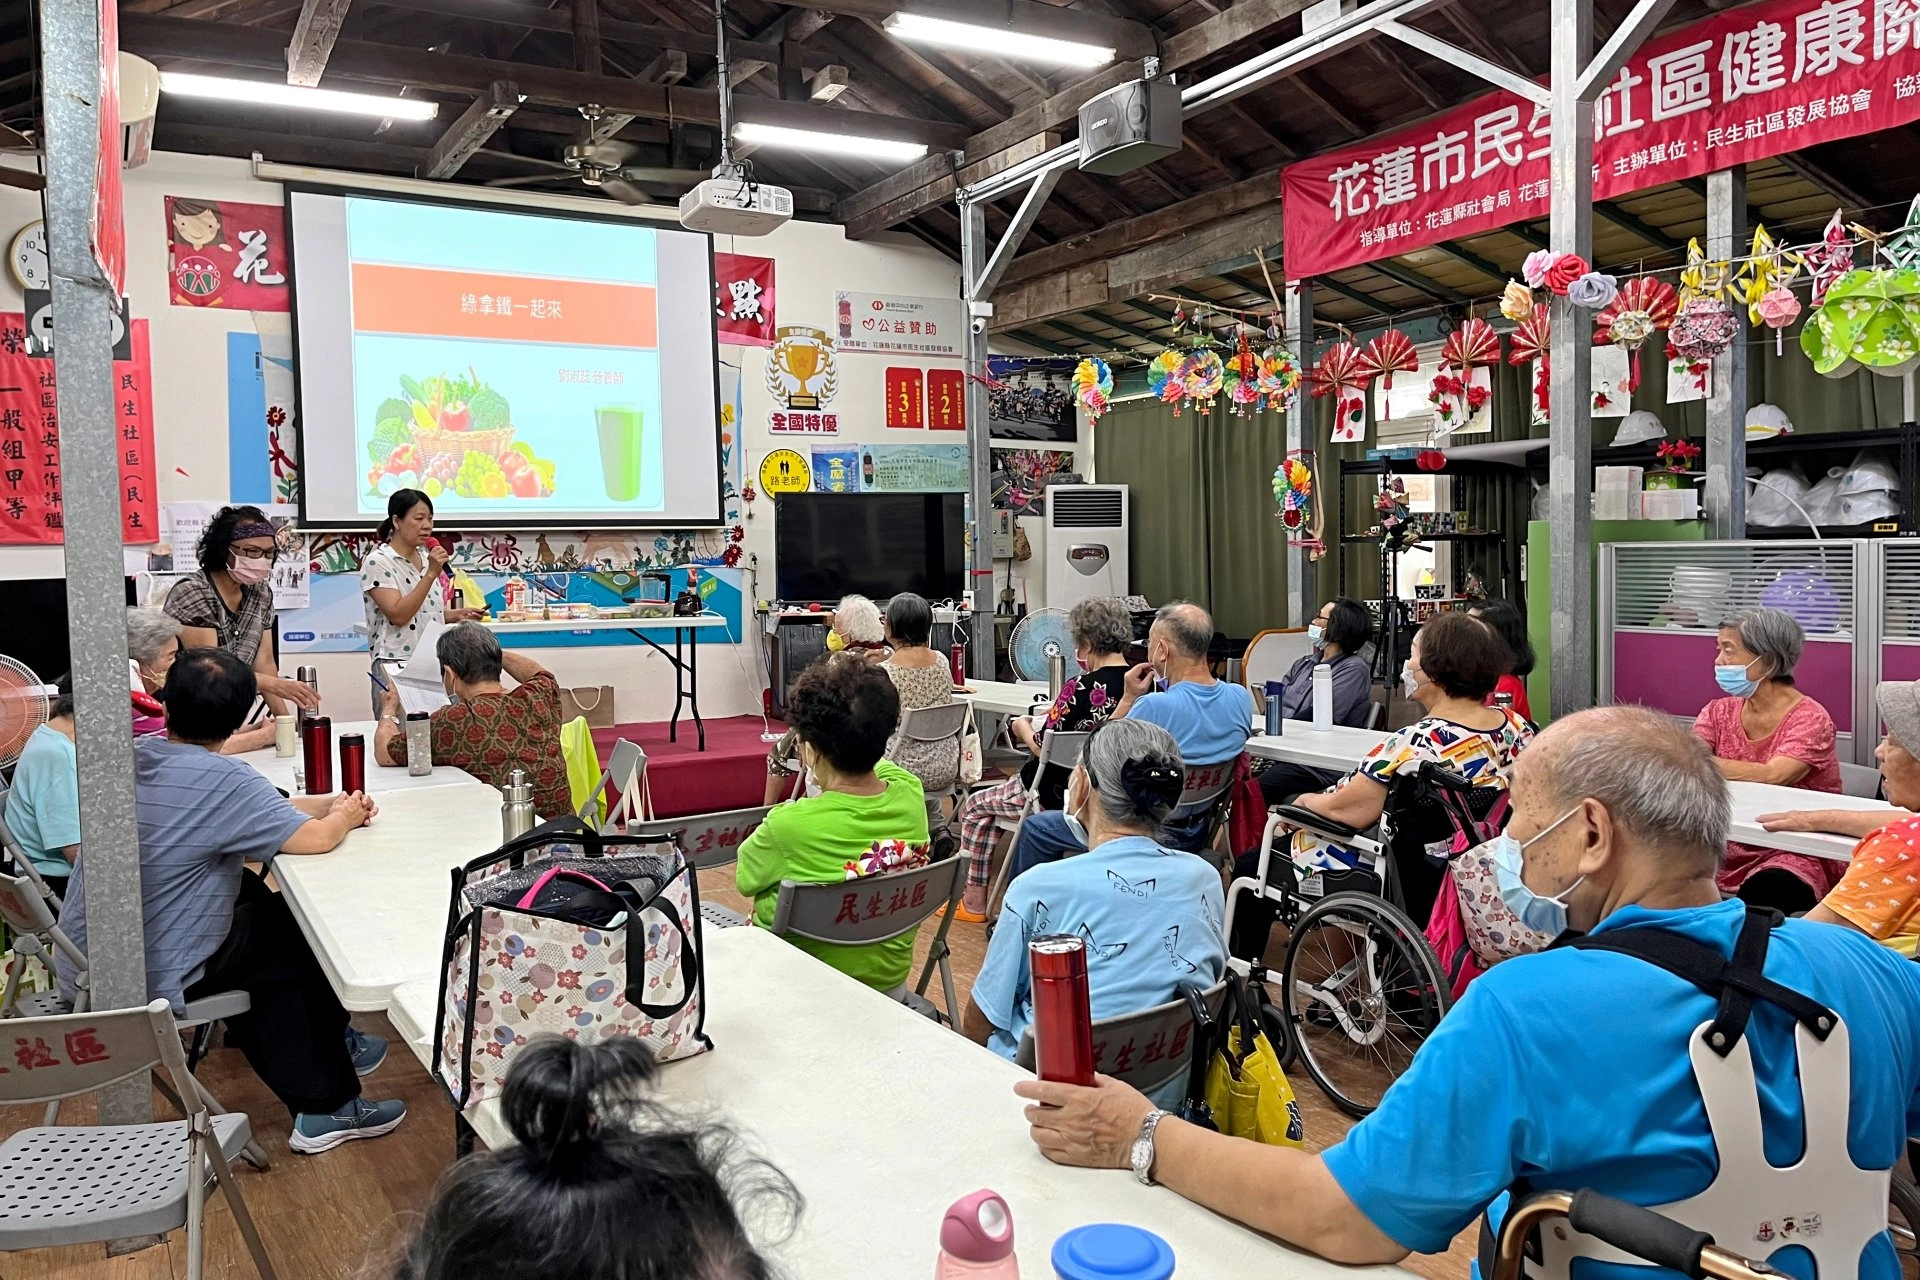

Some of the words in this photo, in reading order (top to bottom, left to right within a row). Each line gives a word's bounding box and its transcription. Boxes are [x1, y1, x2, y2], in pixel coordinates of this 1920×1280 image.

[26, 241, 35, 249] 10
[21, 255, 28, 263] 9
[233, 229, 285, 284] 花
[27, 269, 34, 278] 8
[461, 293, 562, 319] 綠拿鐵一起來
[772, 413, 837, 432] 全國特優
[770, 475, 801, 486] 路老師
[1113, 881, 1148, 899] FENDI
[835, 879, 929, 924] 民生社區
[1162, 935, 1182, 971] FENDI
